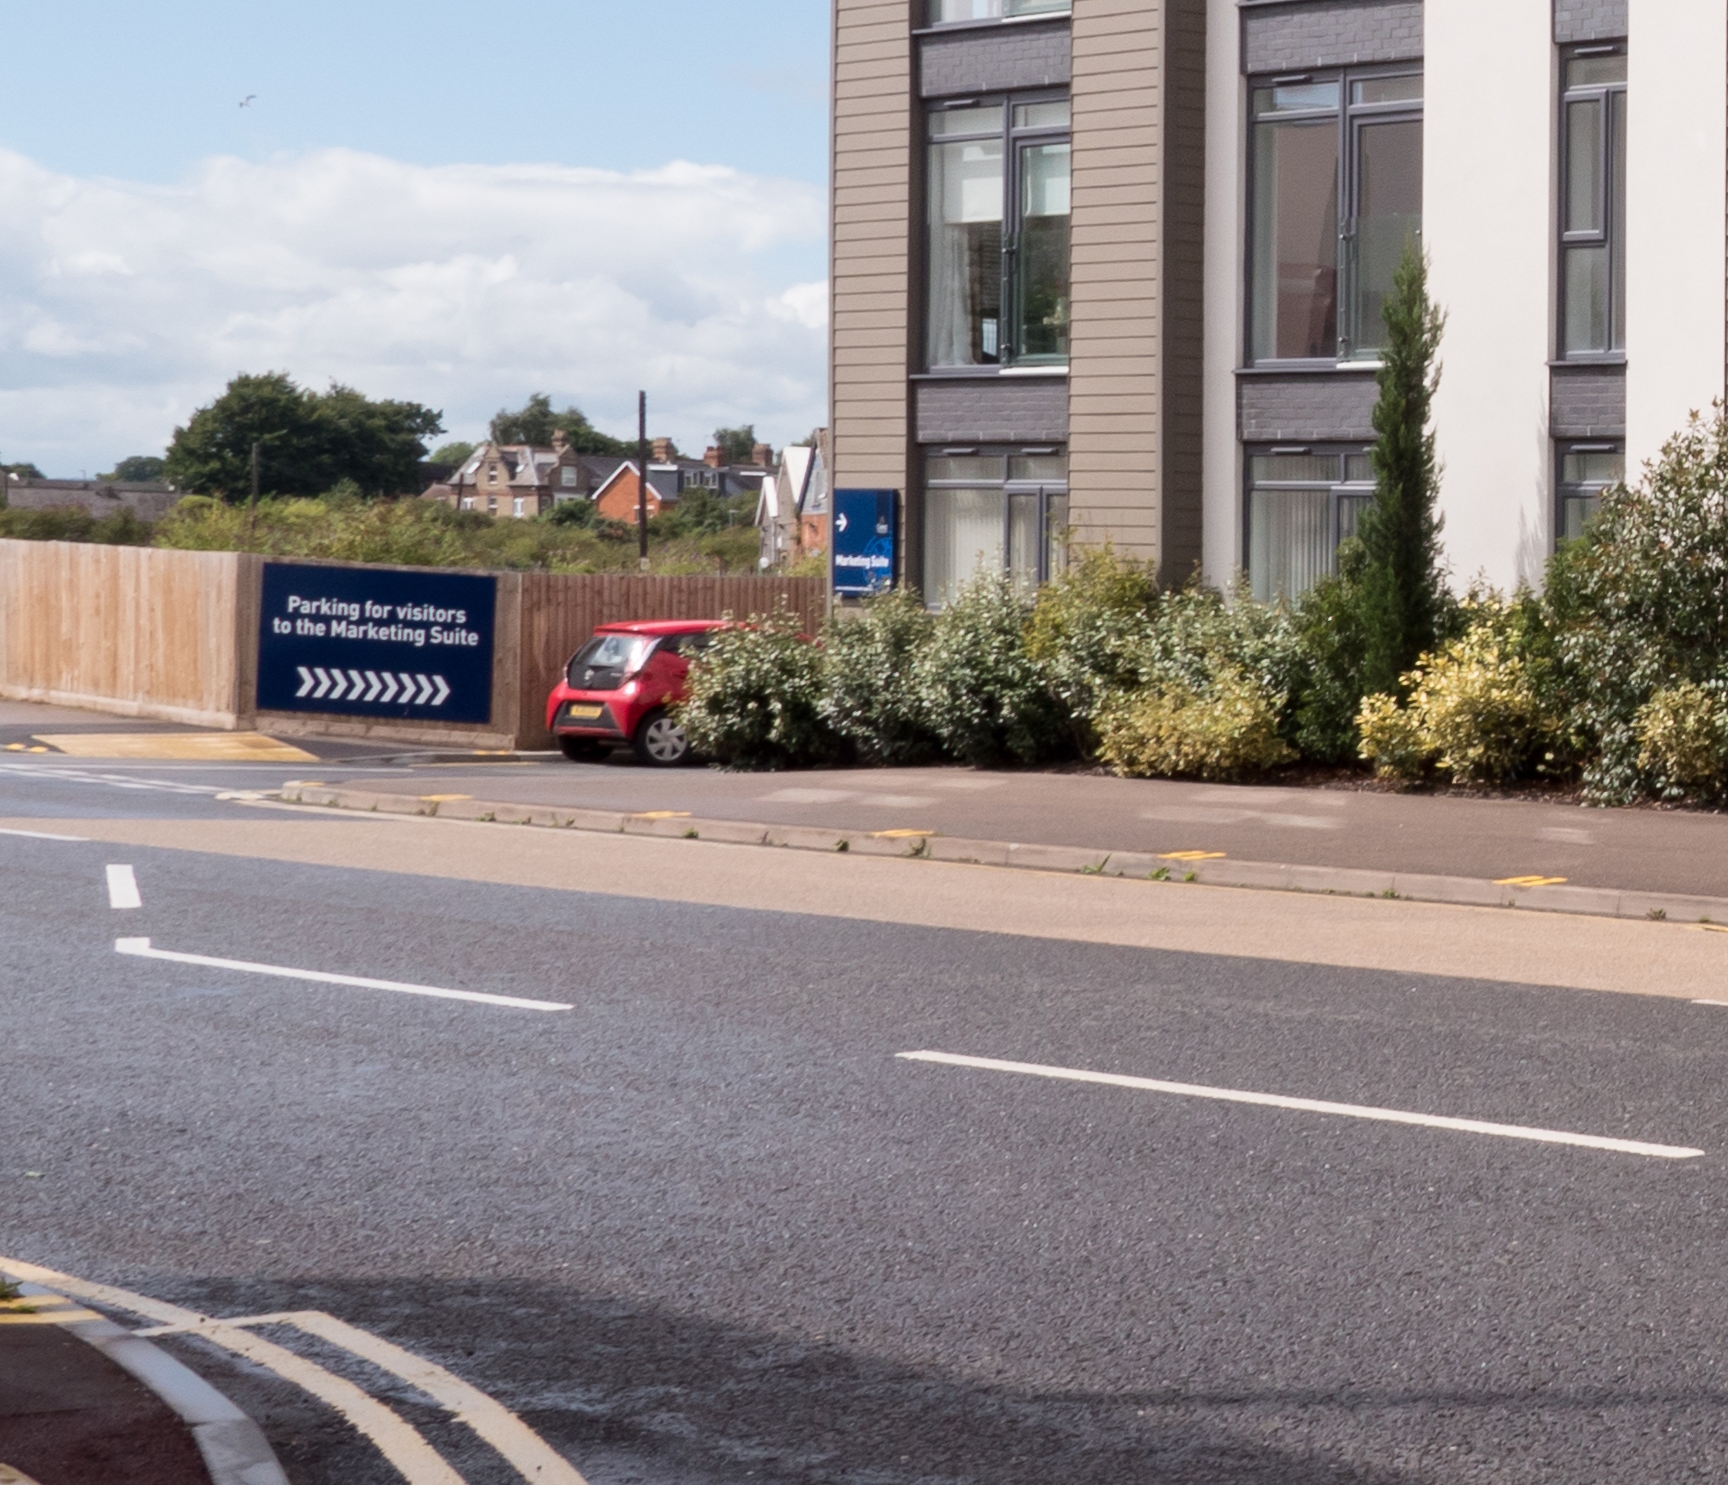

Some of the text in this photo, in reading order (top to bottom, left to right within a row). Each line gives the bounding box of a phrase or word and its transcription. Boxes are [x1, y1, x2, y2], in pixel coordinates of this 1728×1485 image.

[287, 595, 467, 624] Parking for visitors
[273, 617, 479, 647] to the Marketing Suite
